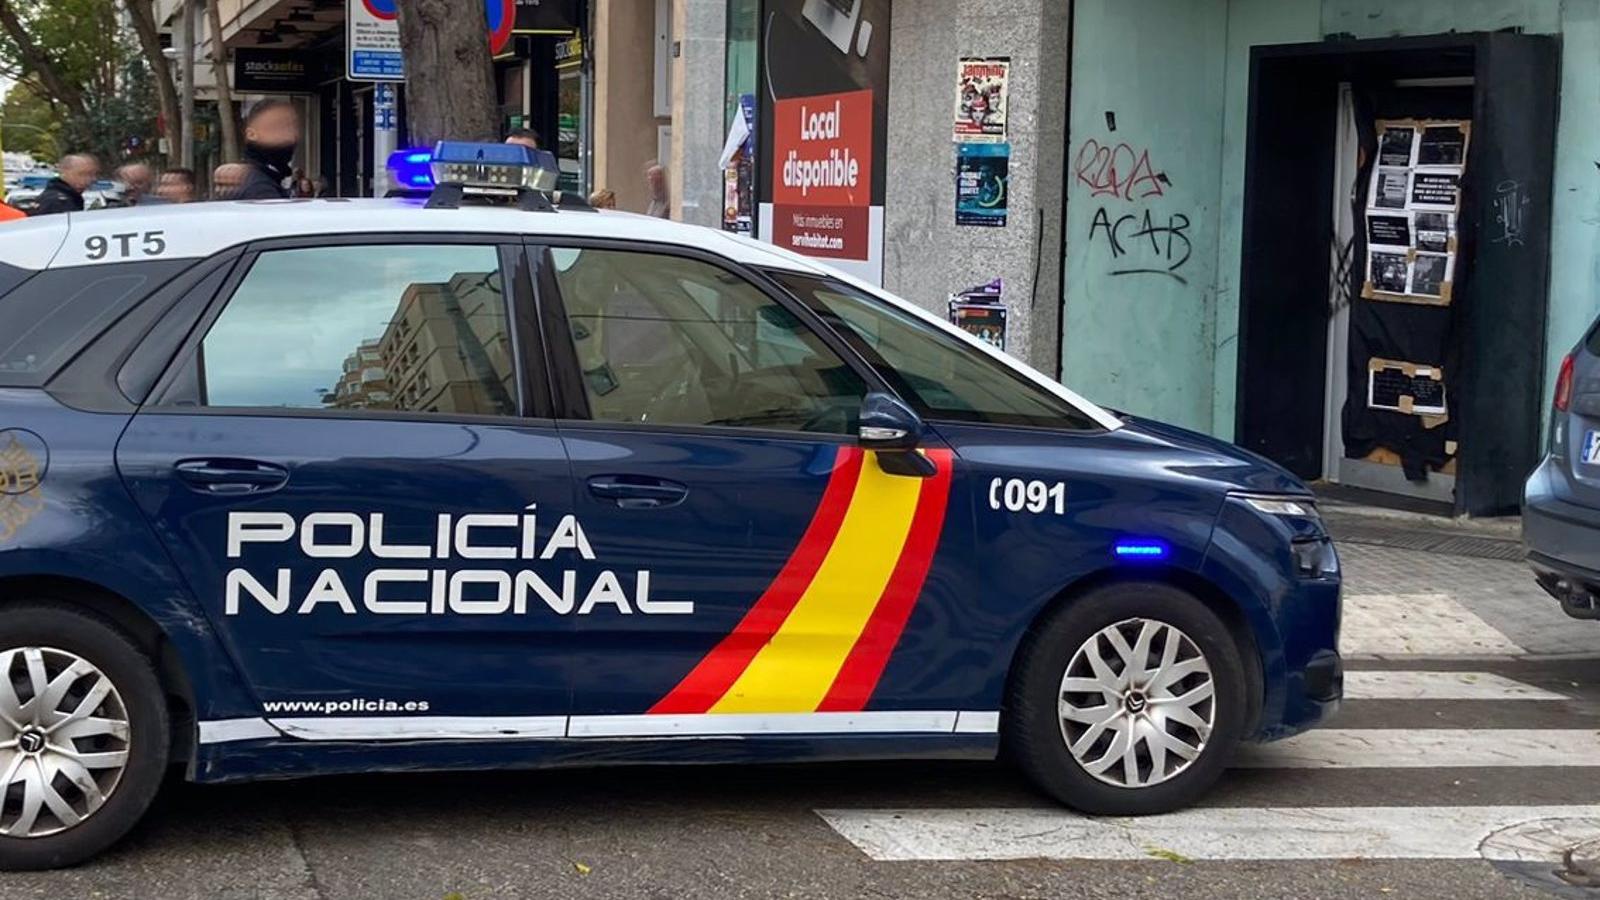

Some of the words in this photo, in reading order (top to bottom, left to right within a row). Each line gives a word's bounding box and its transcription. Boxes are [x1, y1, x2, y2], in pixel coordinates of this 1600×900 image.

[800, 100, 840, 140] Local
[783, 149, 859, 196] disponible
[84, 230, 166, 260] 9T5
[792, 232, 842, 249] servihabitat.com
[1089, 207, 1192, 270] ACAB
[1004, 478, 1065, 515] 091
[227, 503, 596, 559] POLICÍA
[225, 568, 694, 614] NACIONAL
[263, 699, 429, 714] www.policia.es
